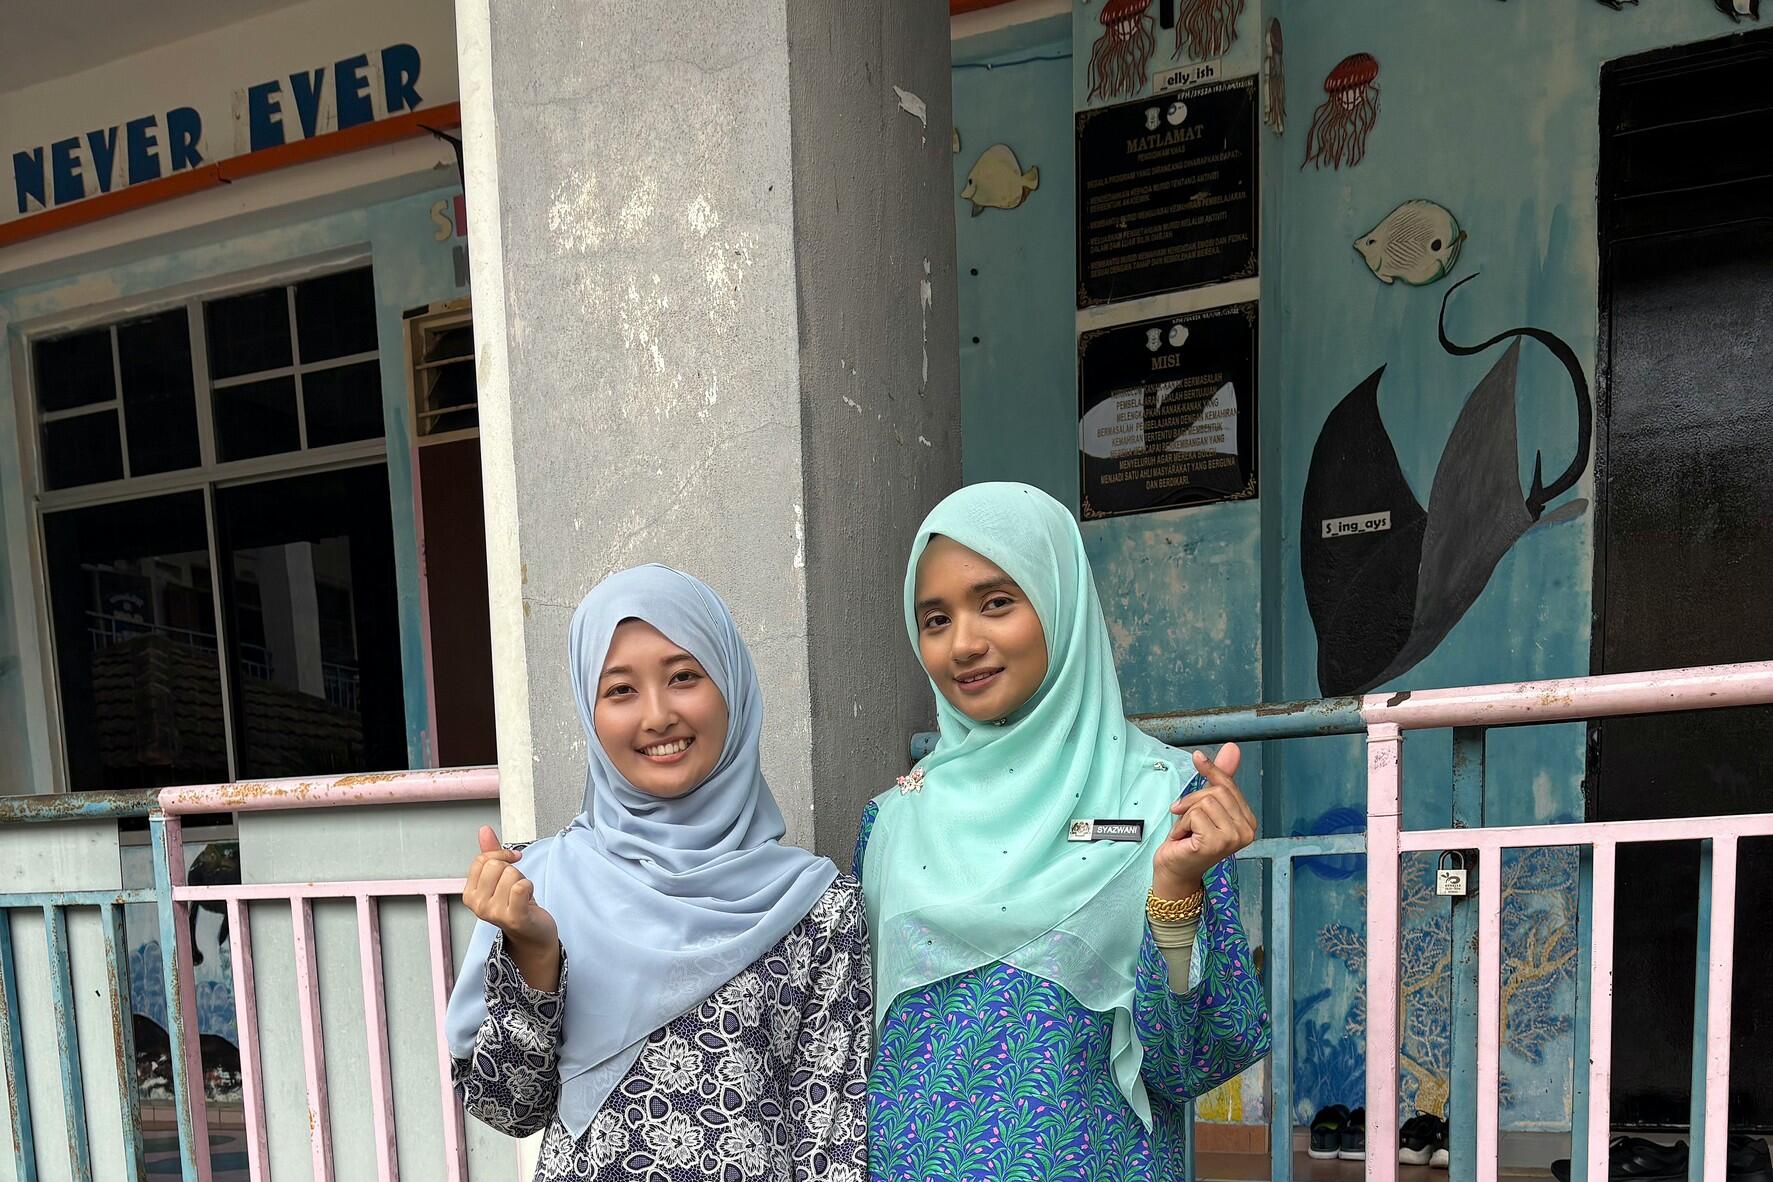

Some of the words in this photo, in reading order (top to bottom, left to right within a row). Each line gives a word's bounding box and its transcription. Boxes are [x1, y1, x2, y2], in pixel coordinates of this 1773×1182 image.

[13, 107, 204, 213] NEVER
[249, 43, 423, 152] EVER
[1127, 123, 1204, 153] MATLAMAT
[1151, 352, 1180, 370] MISI
[1096, 825, 1138, 834] SYAZWANI
